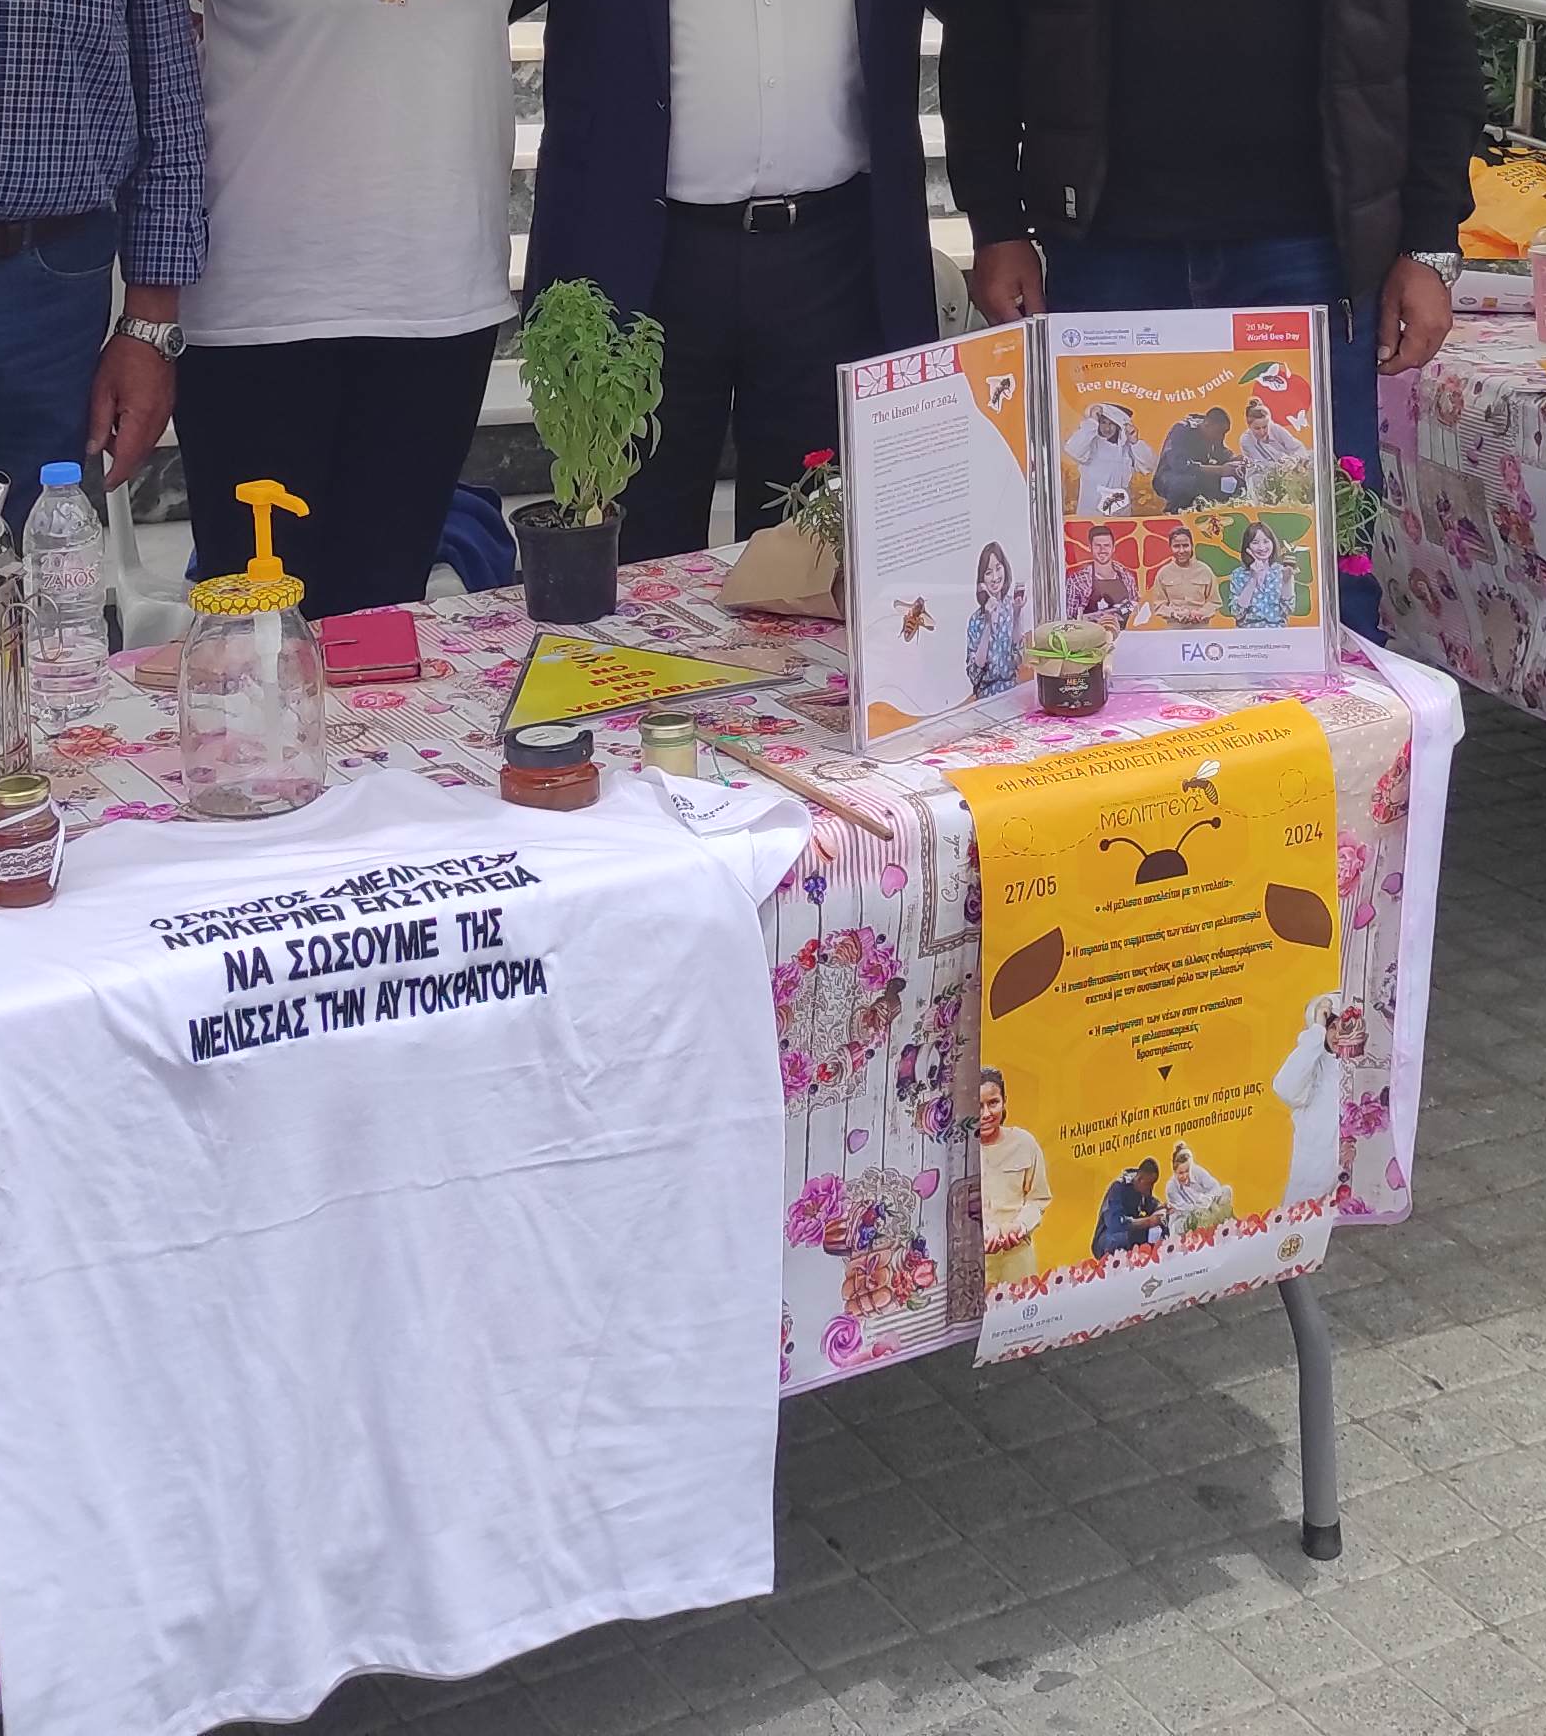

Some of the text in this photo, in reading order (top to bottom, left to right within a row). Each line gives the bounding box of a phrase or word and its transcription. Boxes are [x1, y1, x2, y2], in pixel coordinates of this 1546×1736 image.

[1246, 333, 1268, 342] World
[1285, 333, 1300, 343] Day
[1076, 367, 1236, 403] Bee engaged with youth
[872, 393, 958, 425] The theme for 2024
[589, 670, 657, 687] BEES
[591, 664, 629, 676] NO
[611, 682, 651, 692] NO
[565, 678, 731, 714] VEGETABLES
[1089, 747, 1175, 777] ΑΣΧΟΛΕΙΤΑΙ
[1177, 743, 1198, 761] ΜΕ
[1200, 740, 1220, 755] ΤΗ
[1222, 727, 1293, 752] ΝΕΟΛΑΙΑ»
[1283, 822, 1324, 847] 2024
[1004, 875, 1058, 905] 27/05
[149, 917, 173, 931] Ο
[174, 890, 315, 930] ΣΥΛΛΟΓΟΣ
[161, 864, 542, 951] ΝΤΑΚΕΡΝΕΙ ΕΚΣΤΡΑΤΕΙΑ
[223, 907, 504, 992] ΝΑ ΣΩΣΟΥΜΕ ΤΗΣ
[188, 957, 548, 1063] ΜΕΛΙΣΣΑΣ ΤΗΝ ΑΥΤΟΚΡΑΤΟΡΙΑ
[1060, 1127, 1067, 1140] Η
[1070, 1113, 1119, 1139] κλιματική
[1153, 1096, 1191, 1117] κτυπάει
[1193, 1094, 1210, 1107] την
[1212, 1086, 1241, 1103] πόρτα
[1099, 1133, 1122, 1156] μαζί
[1123, 1127, 1158, 1148] πρέπει
[1159, 1126, 1172, 1137] να
